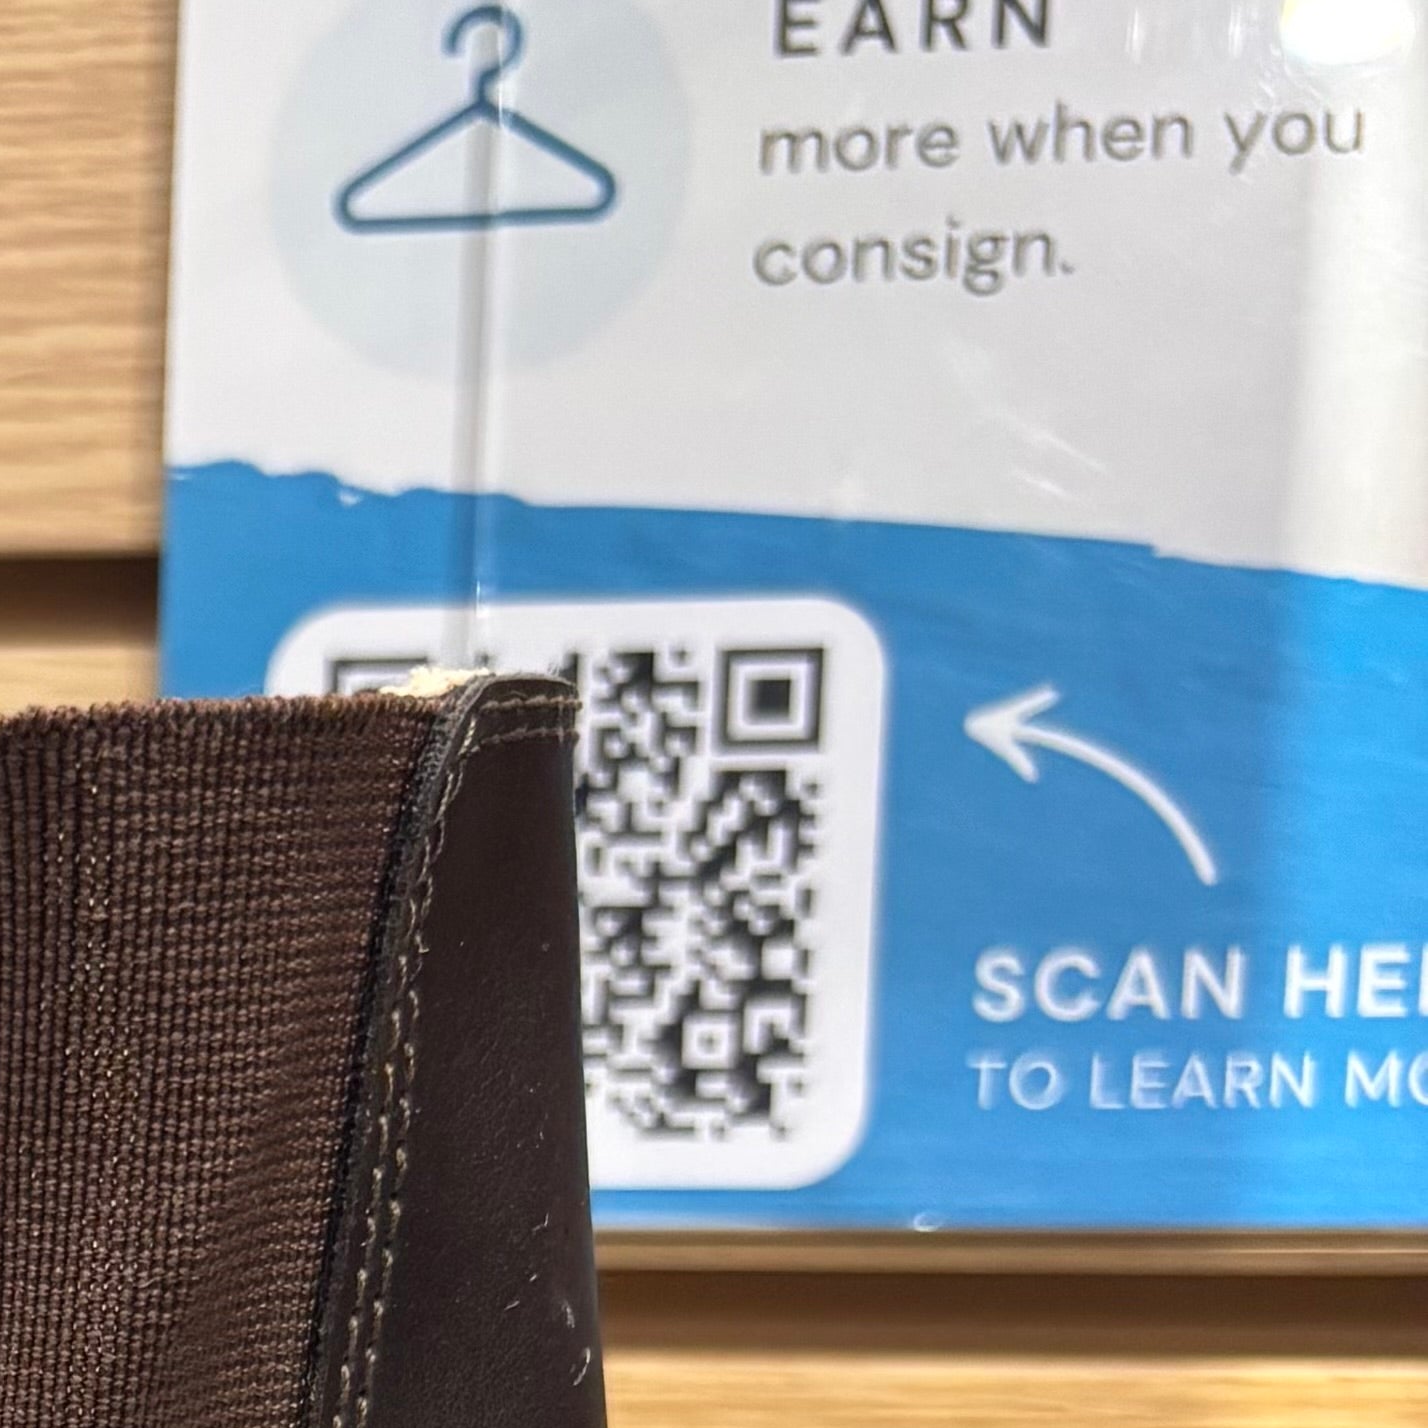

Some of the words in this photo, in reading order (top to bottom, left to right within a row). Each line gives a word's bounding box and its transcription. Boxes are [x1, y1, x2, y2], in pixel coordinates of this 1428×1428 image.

[774, 0, 1050, 57] EARN
[758, 122, 960, 174] more
[988, 100, 1194, 163] when
[1225, 106, 1366, 175] you
[752, 216, 1076, 296] consign.
[972, 944, 1247, 1023] SCAN
[1283, 942, 1428, 1019] HE
[966, 1050, 1063, 1111] TO
[1089, 1050, 1316, 1110] LEARN
